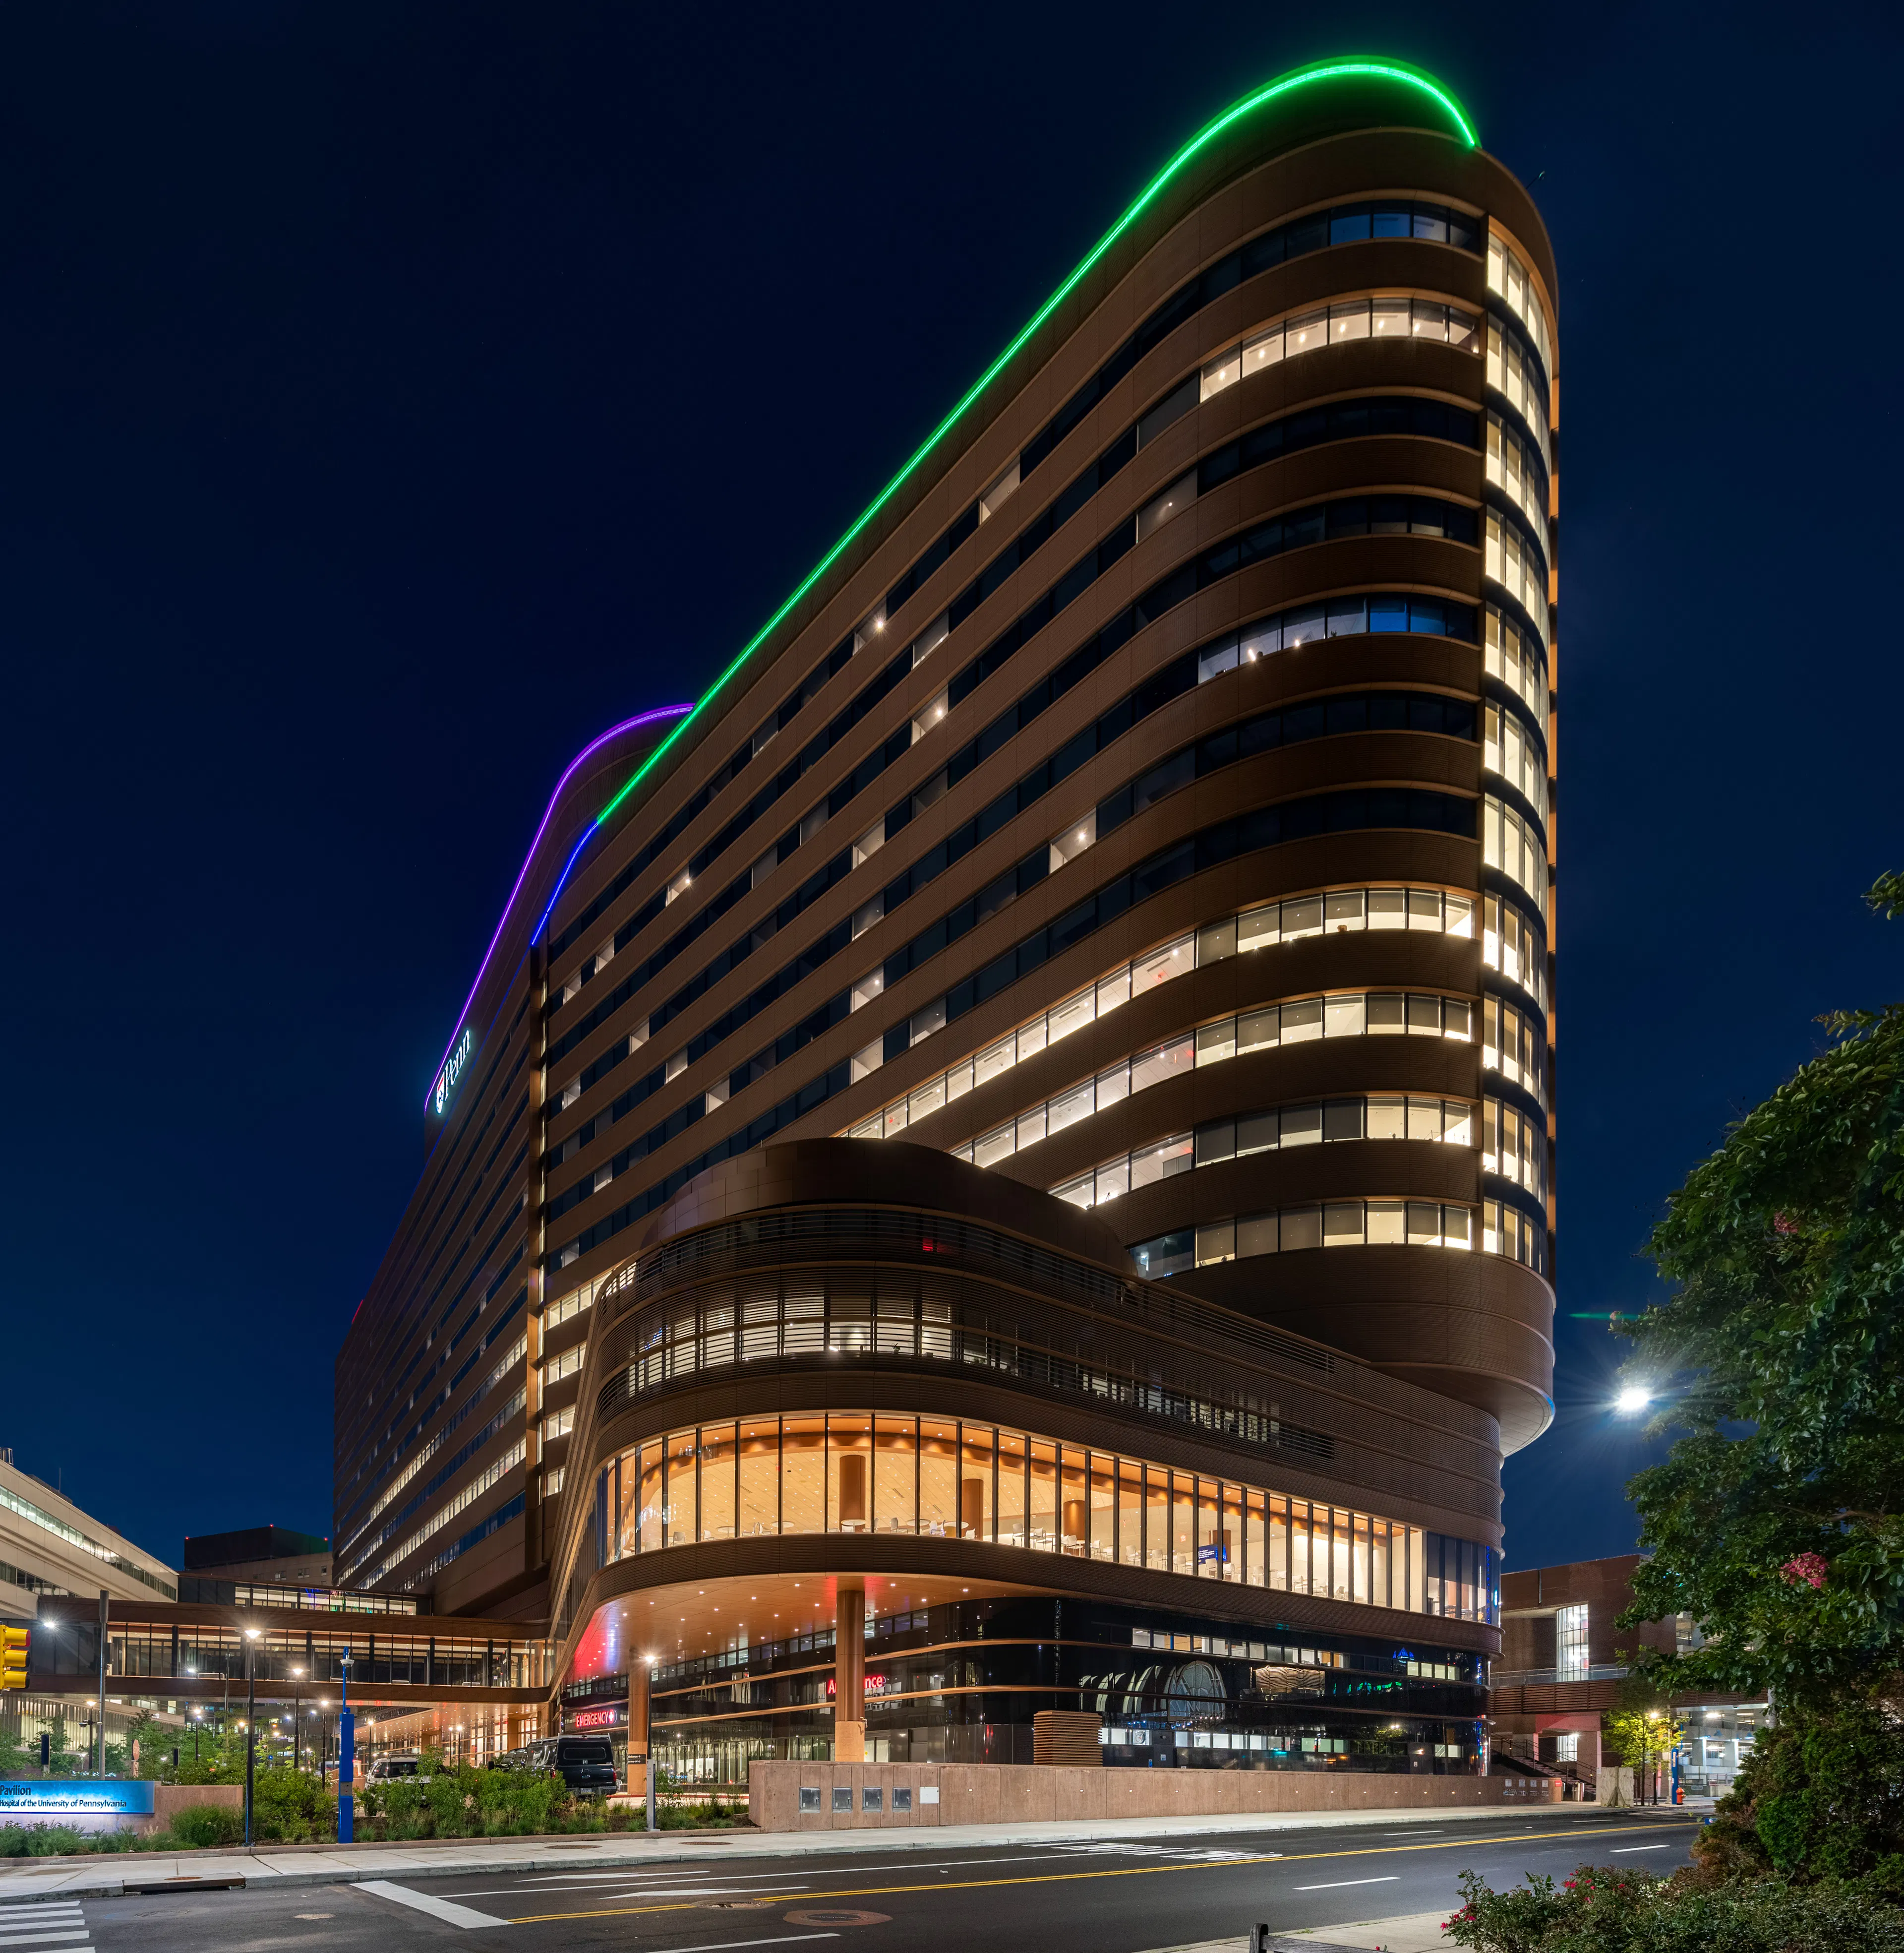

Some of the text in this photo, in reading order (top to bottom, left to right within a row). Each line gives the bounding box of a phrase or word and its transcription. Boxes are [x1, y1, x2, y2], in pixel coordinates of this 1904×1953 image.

[445, 1030, 470, 1101] Penn
[576, 1711, 609, 1727] EMERGENCY
[0, 1784, 31, 1795] Pavilion
[0, 1799, 19, 1808] Hospital
[38, 1800, 69, 1809] University
[79, 1799, 127, 1809] Pennsylvania
